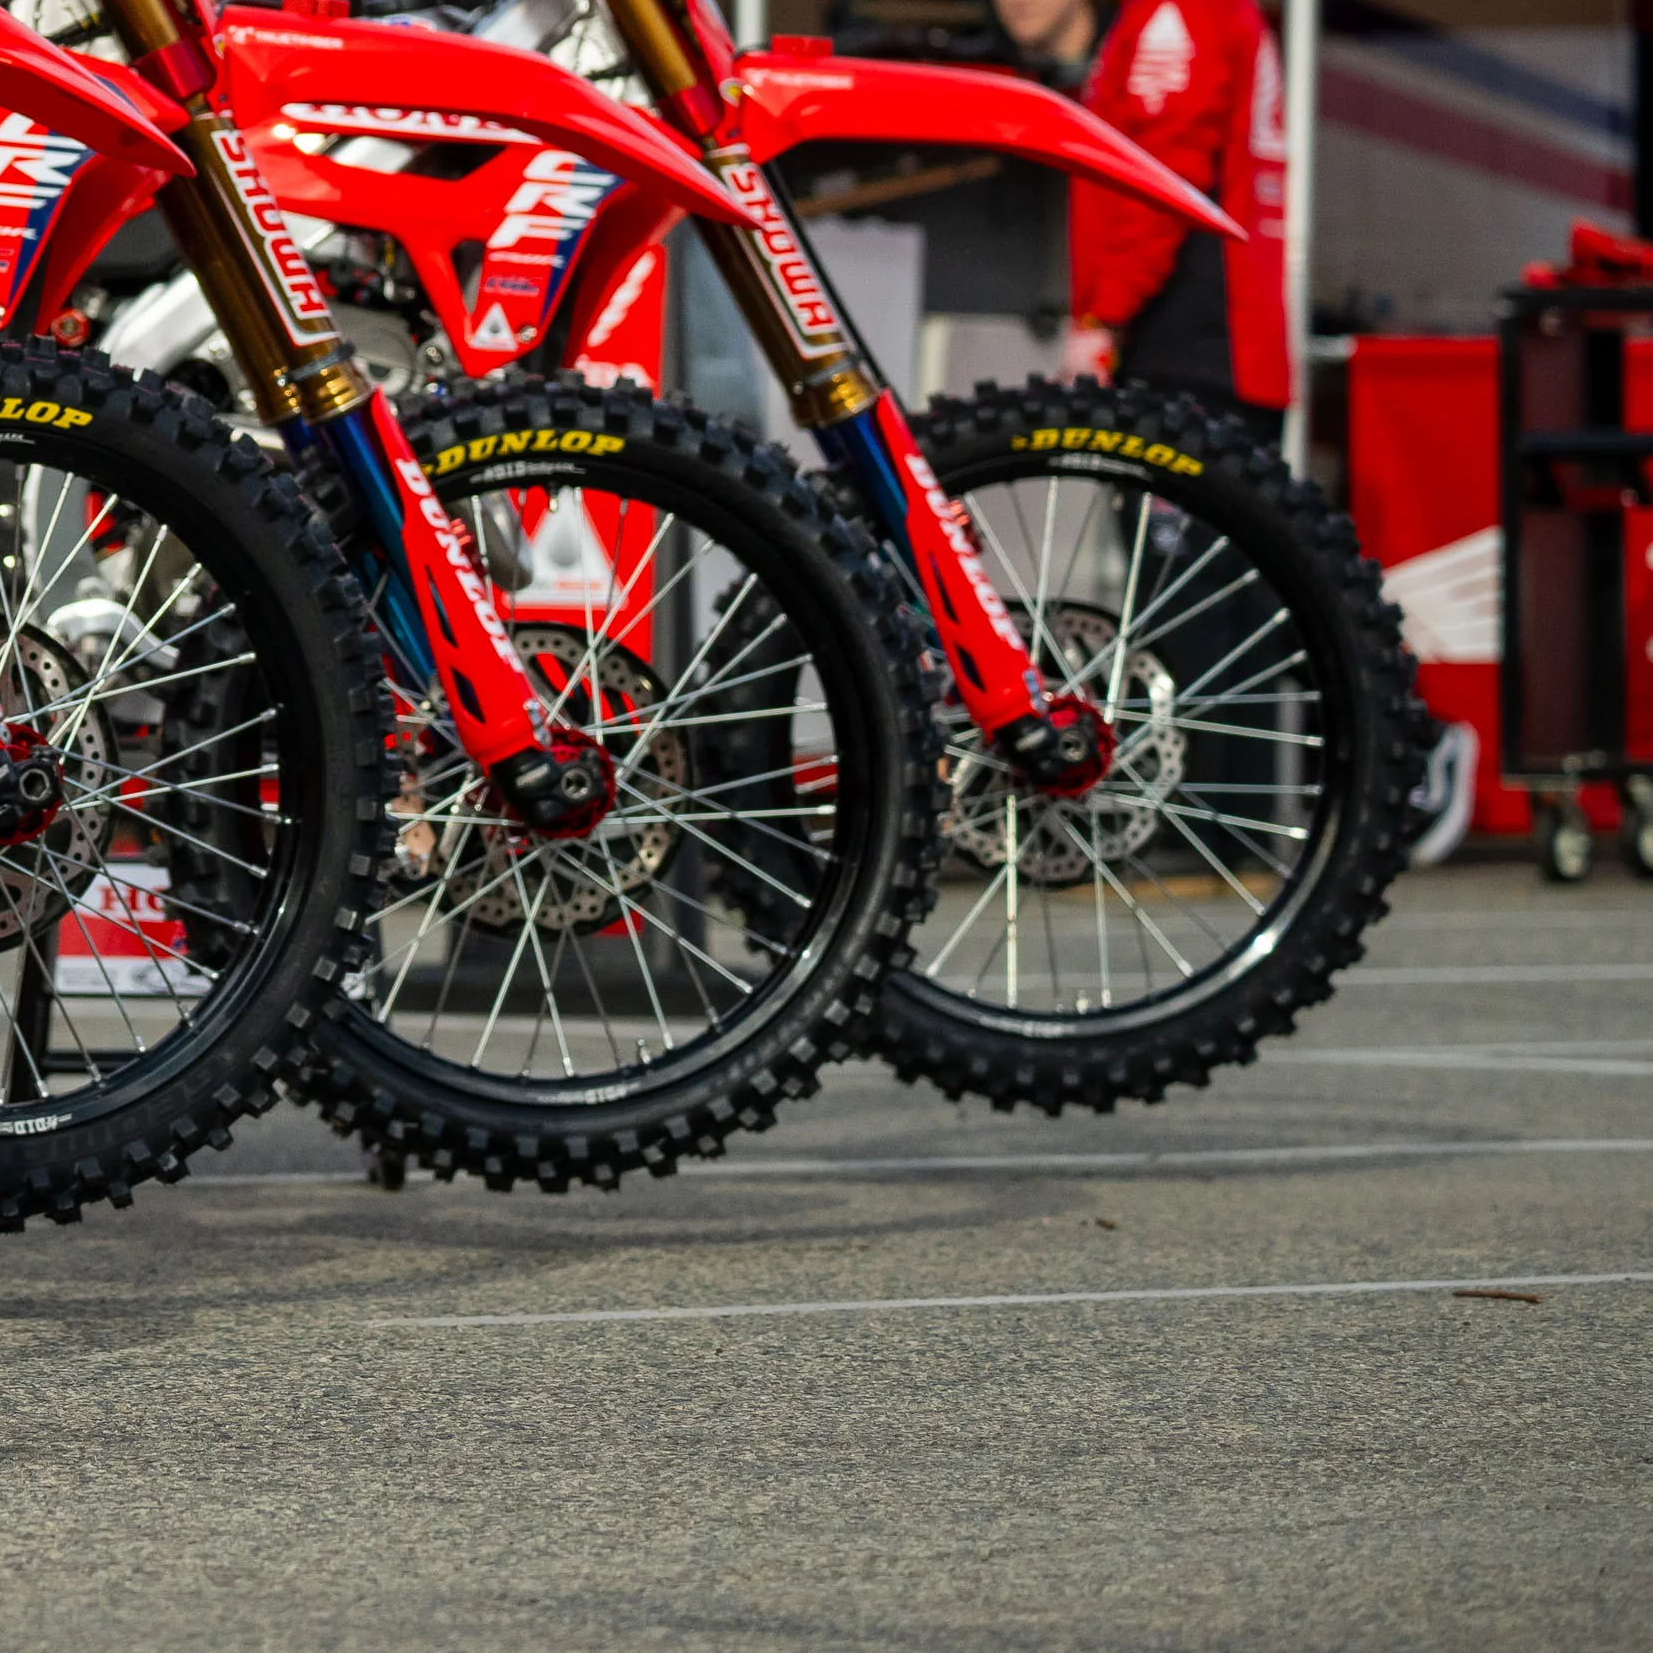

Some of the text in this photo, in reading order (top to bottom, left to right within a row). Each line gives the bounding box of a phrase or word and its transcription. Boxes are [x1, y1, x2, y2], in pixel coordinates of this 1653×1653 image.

[435, 429, 627, 475] DUNLOP
[1029, 427, 1203, 476] DUNLOP
[345, 458, 527, 673] DUNLOP
